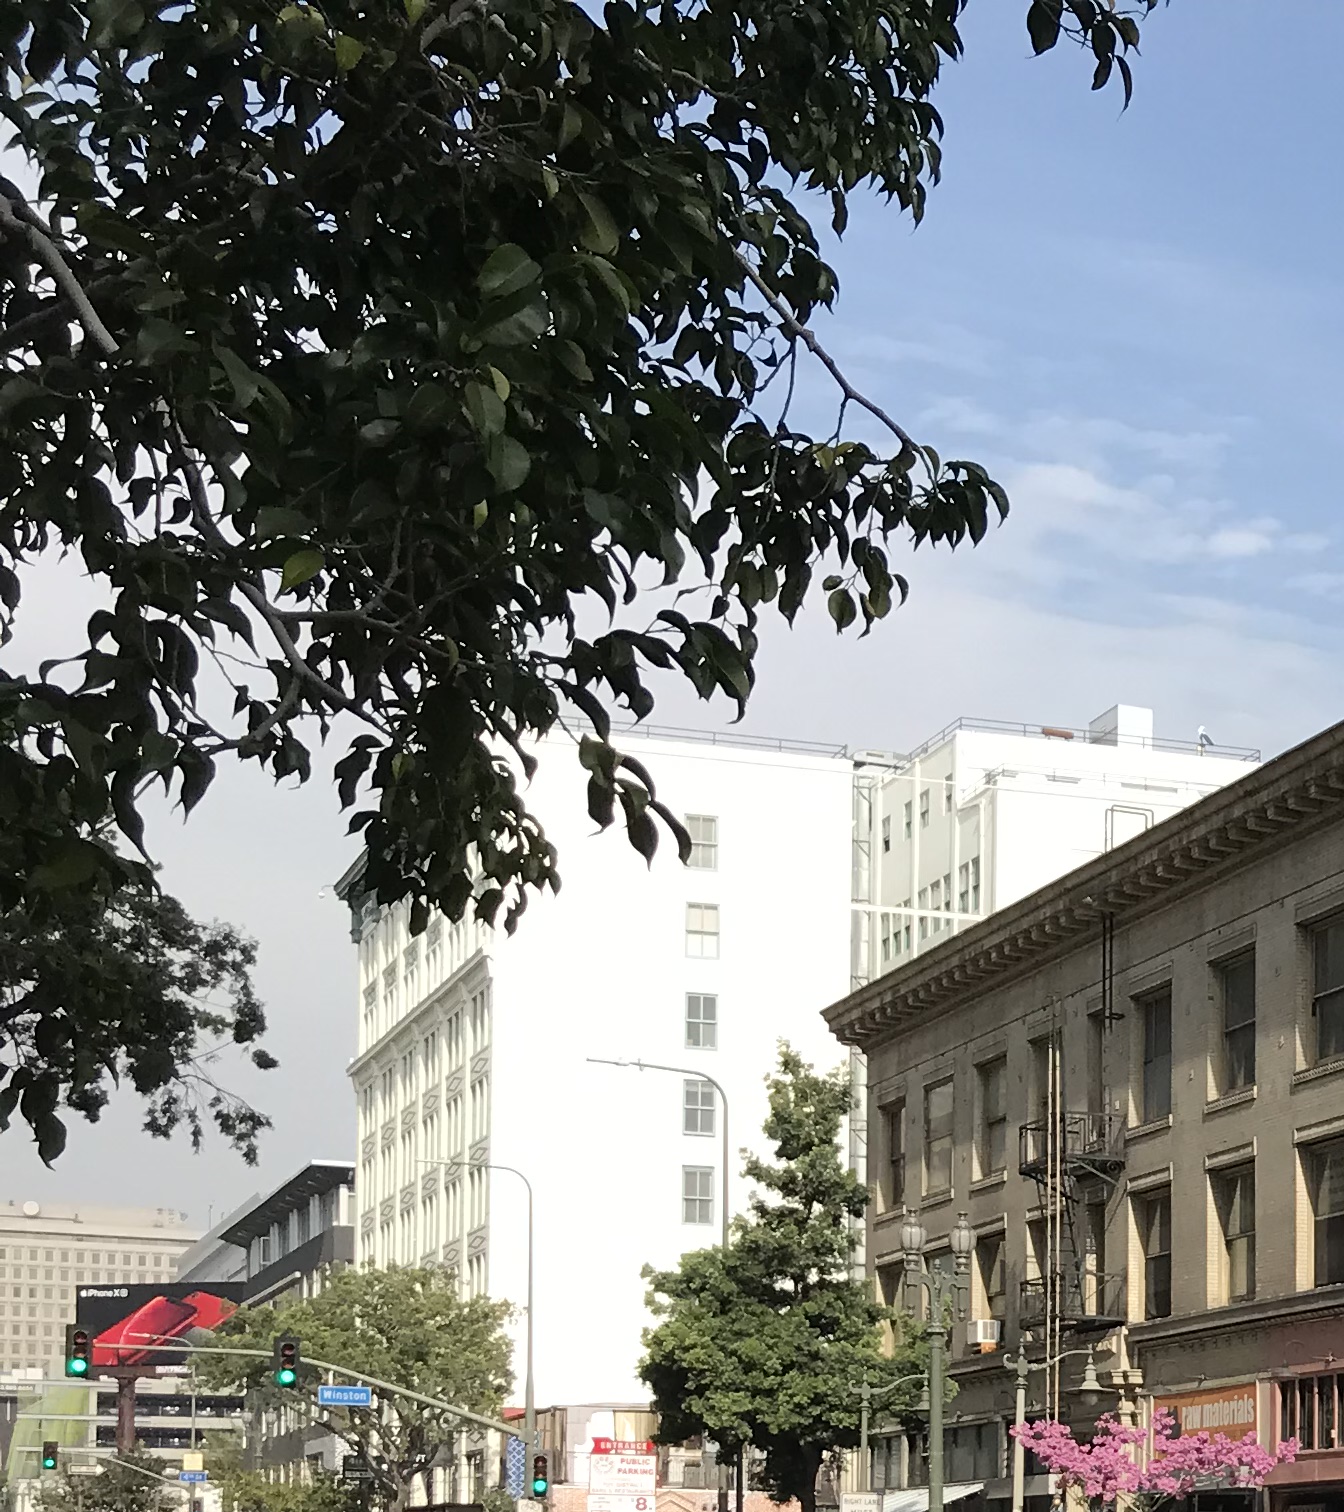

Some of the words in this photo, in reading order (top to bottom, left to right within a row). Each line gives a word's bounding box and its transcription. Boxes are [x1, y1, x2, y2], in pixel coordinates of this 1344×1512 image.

[323, 1390, 367, 1400] Winston
[1182, 1405, 1201, 1430] raw
[1202, 1393, 1254, 1427] materials
